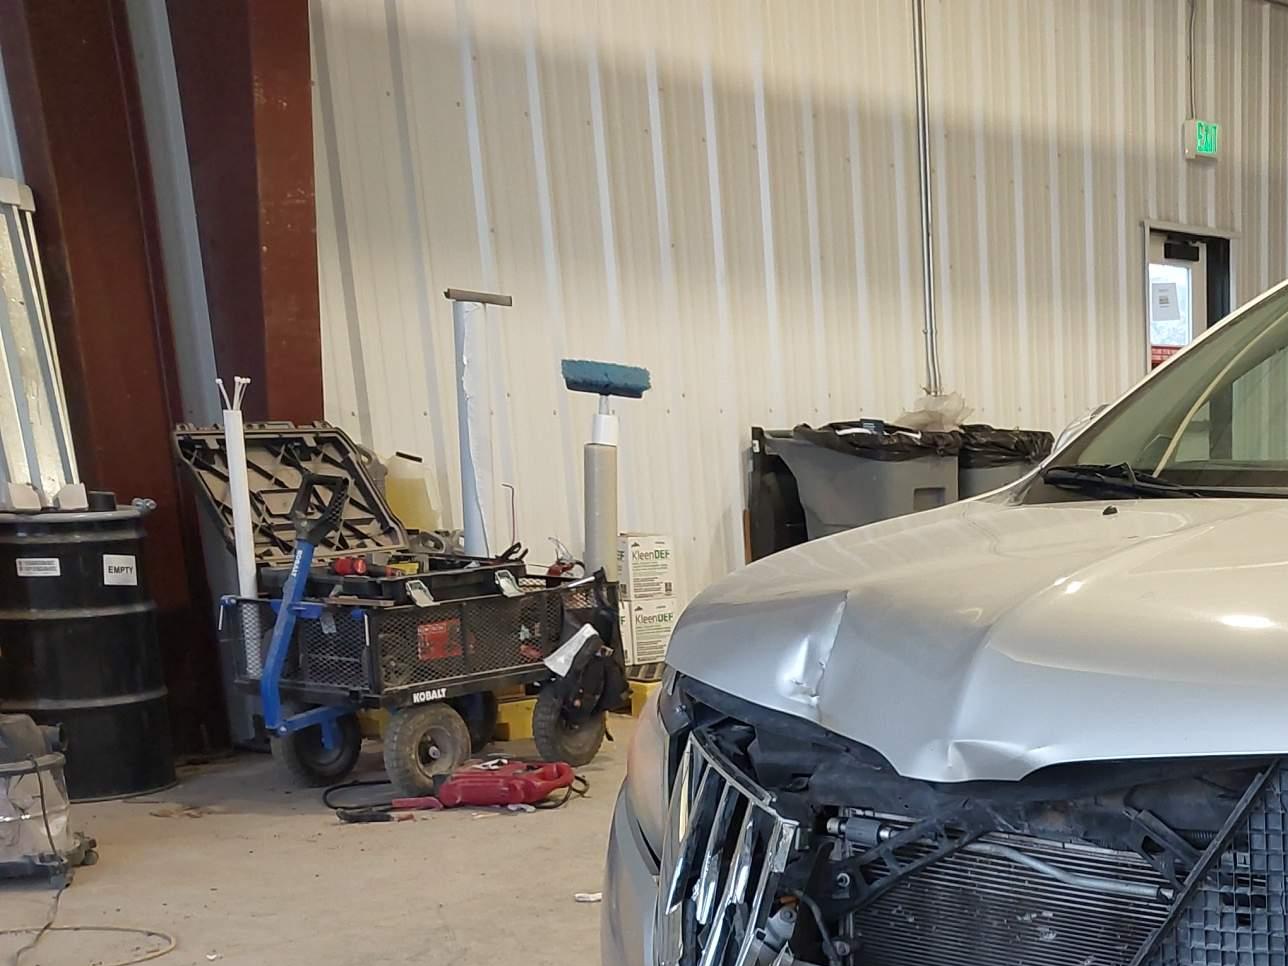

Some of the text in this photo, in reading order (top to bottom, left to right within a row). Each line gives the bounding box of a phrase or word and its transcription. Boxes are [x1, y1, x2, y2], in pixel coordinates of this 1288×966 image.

[1197, 121, 1217, 152] EXIT
[108, 565, 134, 574] EMPTY
[413, 687, 447, 703] KOBALT
